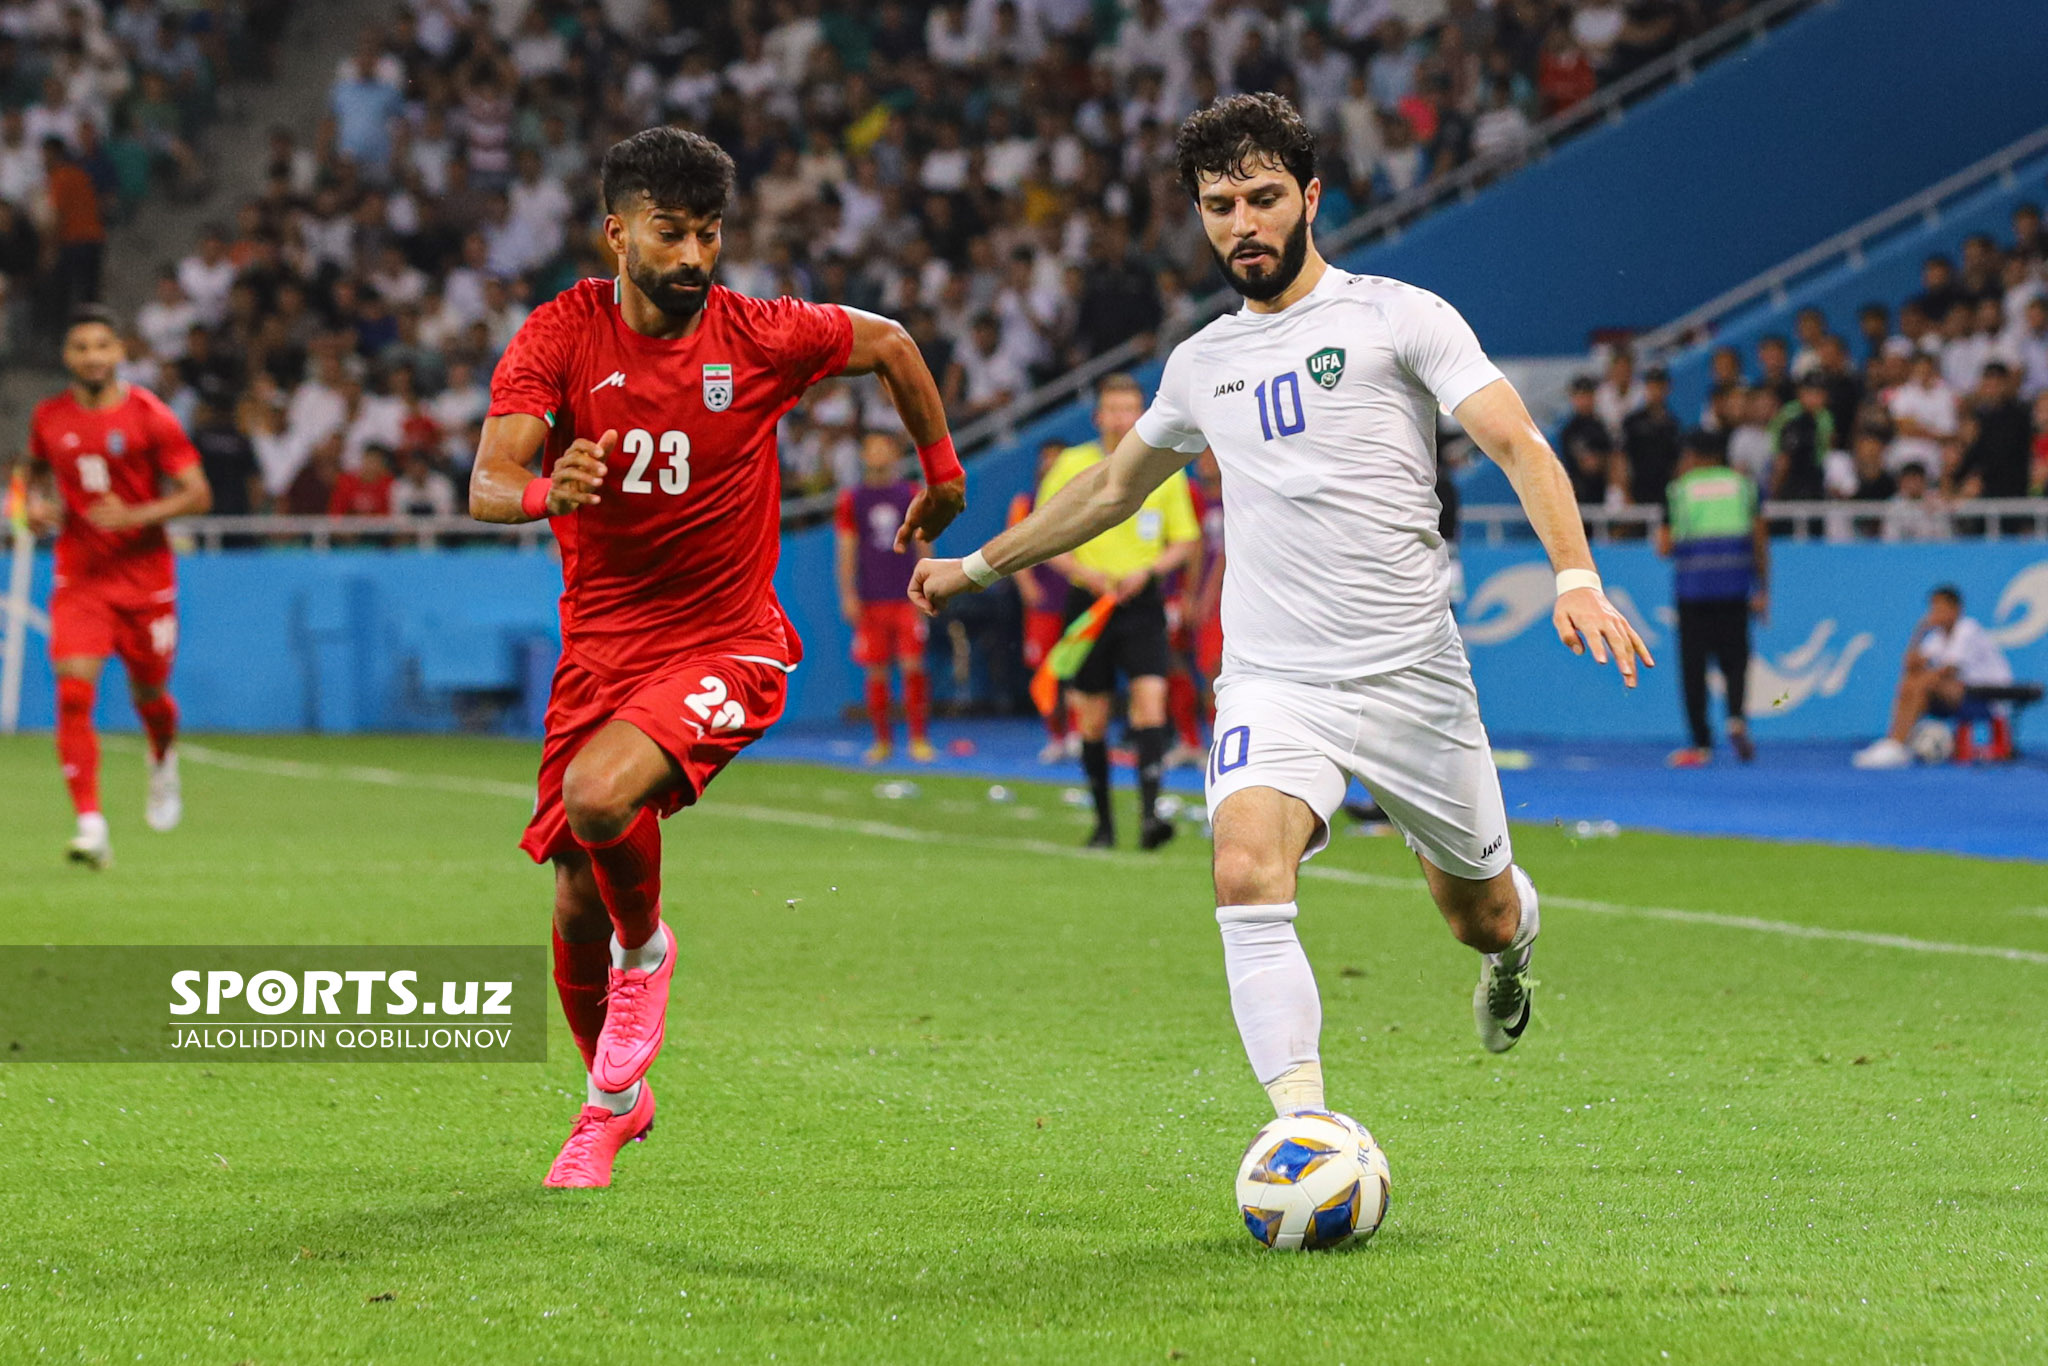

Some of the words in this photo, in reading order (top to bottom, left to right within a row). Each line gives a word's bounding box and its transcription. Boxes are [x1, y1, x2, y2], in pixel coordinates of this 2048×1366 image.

[1311, 353, 1342, 373] UFA
[1213, 380, 1245, 398] JAKO
[1254, 371, 1306, 441] 10
[622, 428, 691, 495] 23
[1210, 725, 1250, 789] 10
[1481, 834, 1503, 859] JAKO
